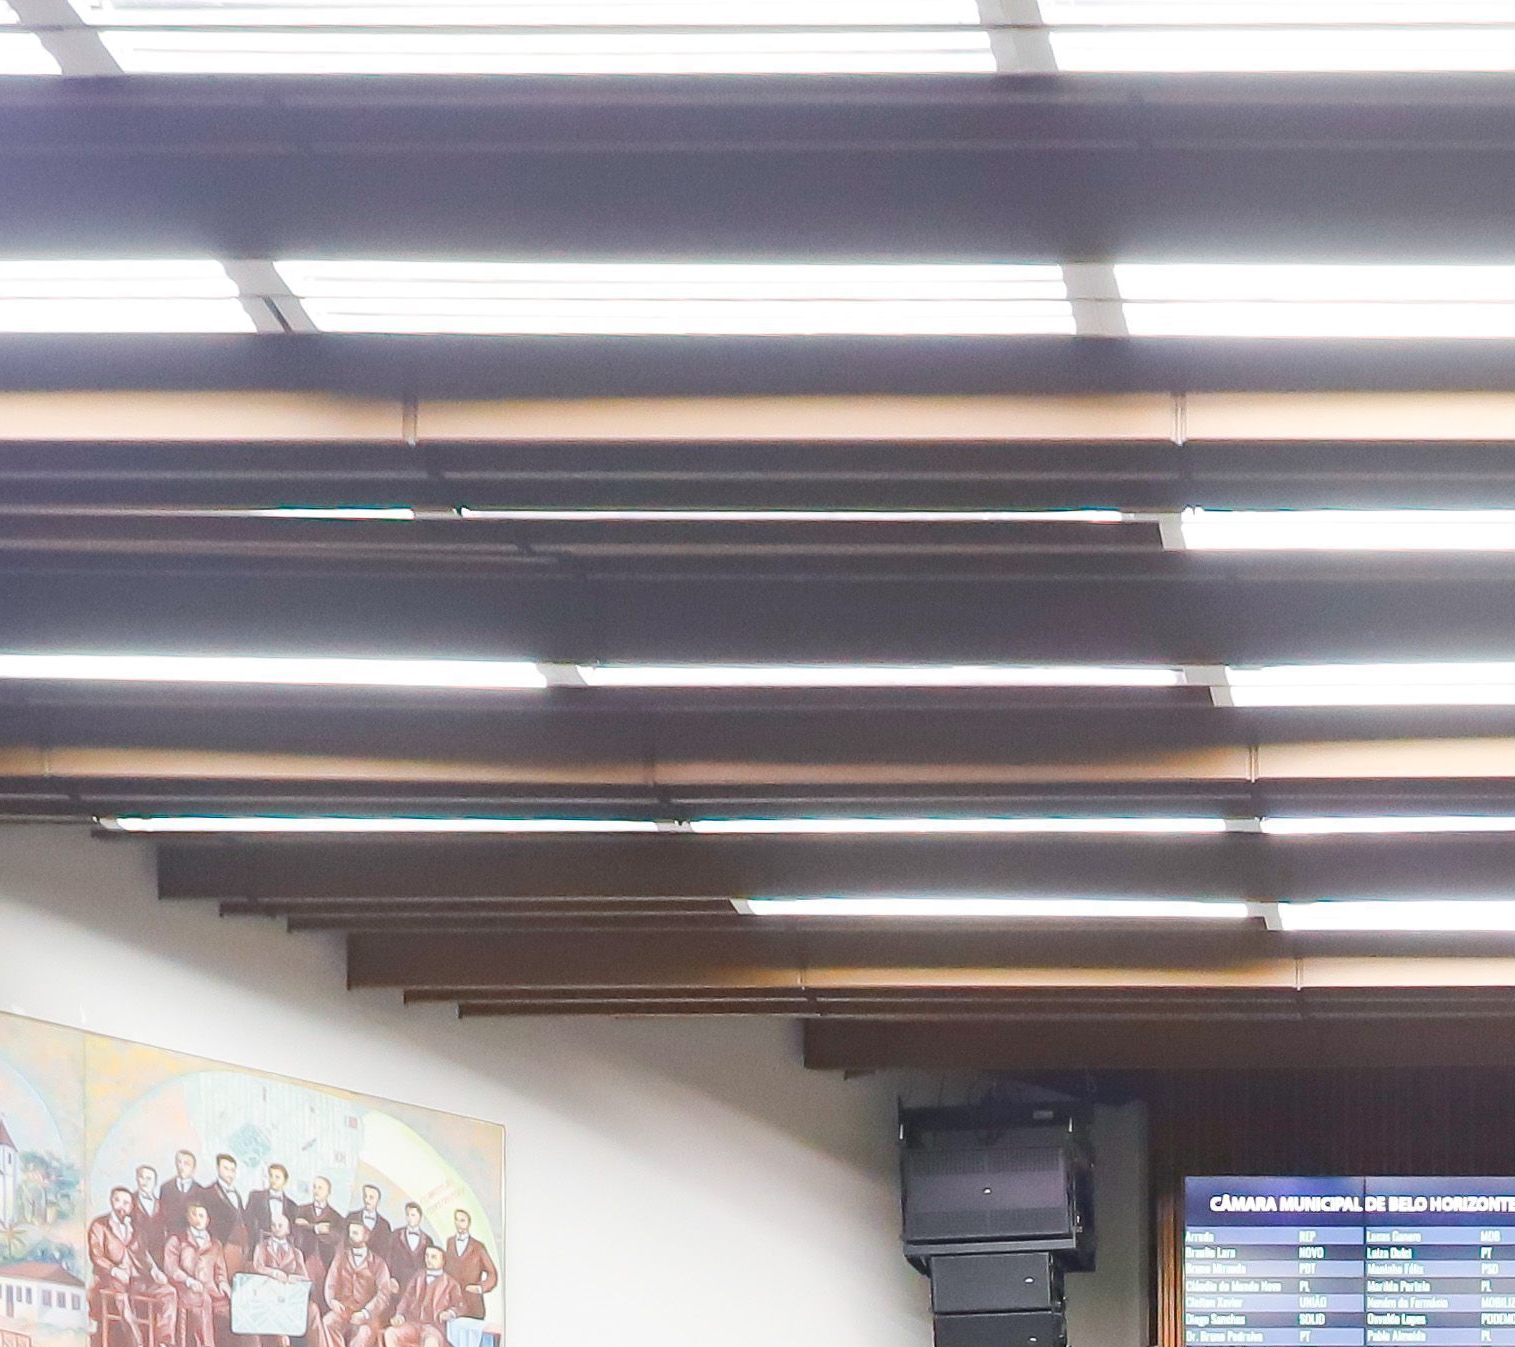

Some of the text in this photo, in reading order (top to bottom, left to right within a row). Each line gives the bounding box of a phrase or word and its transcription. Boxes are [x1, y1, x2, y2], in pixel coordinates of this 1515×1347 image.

[1210, 1193, 1277, 1212] CÂMARA
[1279, 1196, 1364, 1212] MUNICIPAL
[1365, 1196, 1386, 1212] DE
[1389, 1196, 1427, 1212] BELO
[1481, 1231, 1500, 1242] MDB
[1299, 1247, 1323, 1259] NOVO
[1481, 1247, 1492, 1259] PT
[1481, 1264, 1499, 1275] PSD
[1299, 1281, 1310, 1292] PL
[1481, 1281, 1492, 1292] PL
[1300, 1295, 1327, 1308] UNIÃO
[1299, 1313, 1325, 1325] SOLID
[1300, 1331, 1311, 1342] PT
[1481, 1331, 1492, 1342] PL
